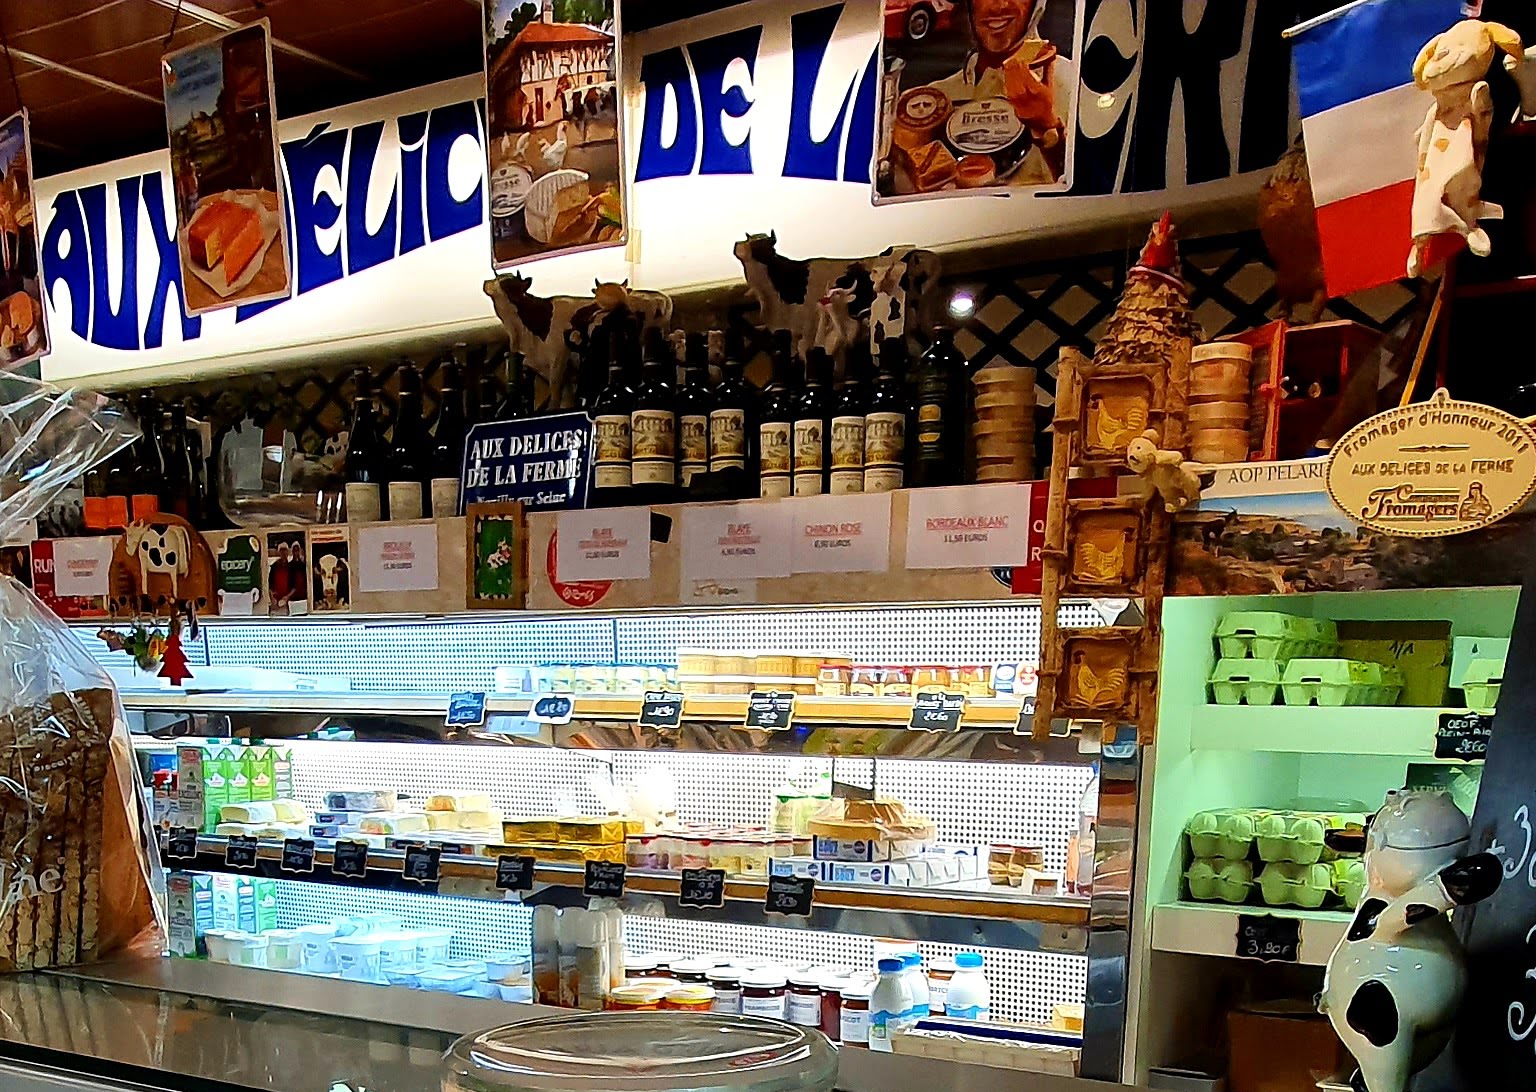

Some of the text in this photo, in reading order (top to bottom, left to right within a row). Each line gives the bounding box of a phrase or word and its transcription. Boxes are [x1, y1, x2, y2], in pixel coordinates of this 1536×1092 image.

[635, 25, 764, 183] DE
[470, 429, 583, 460] AUX DELICES
[1343, 410, 1531, 459] Fromager d'Honneur 2011
[466, 458, 582, 488] DE LA FERME
[1228, 468, 1263, 484] AOP
[1351, 463, 1376, 475] AUX
[926, 517, 974, 530] BORDEAUX
